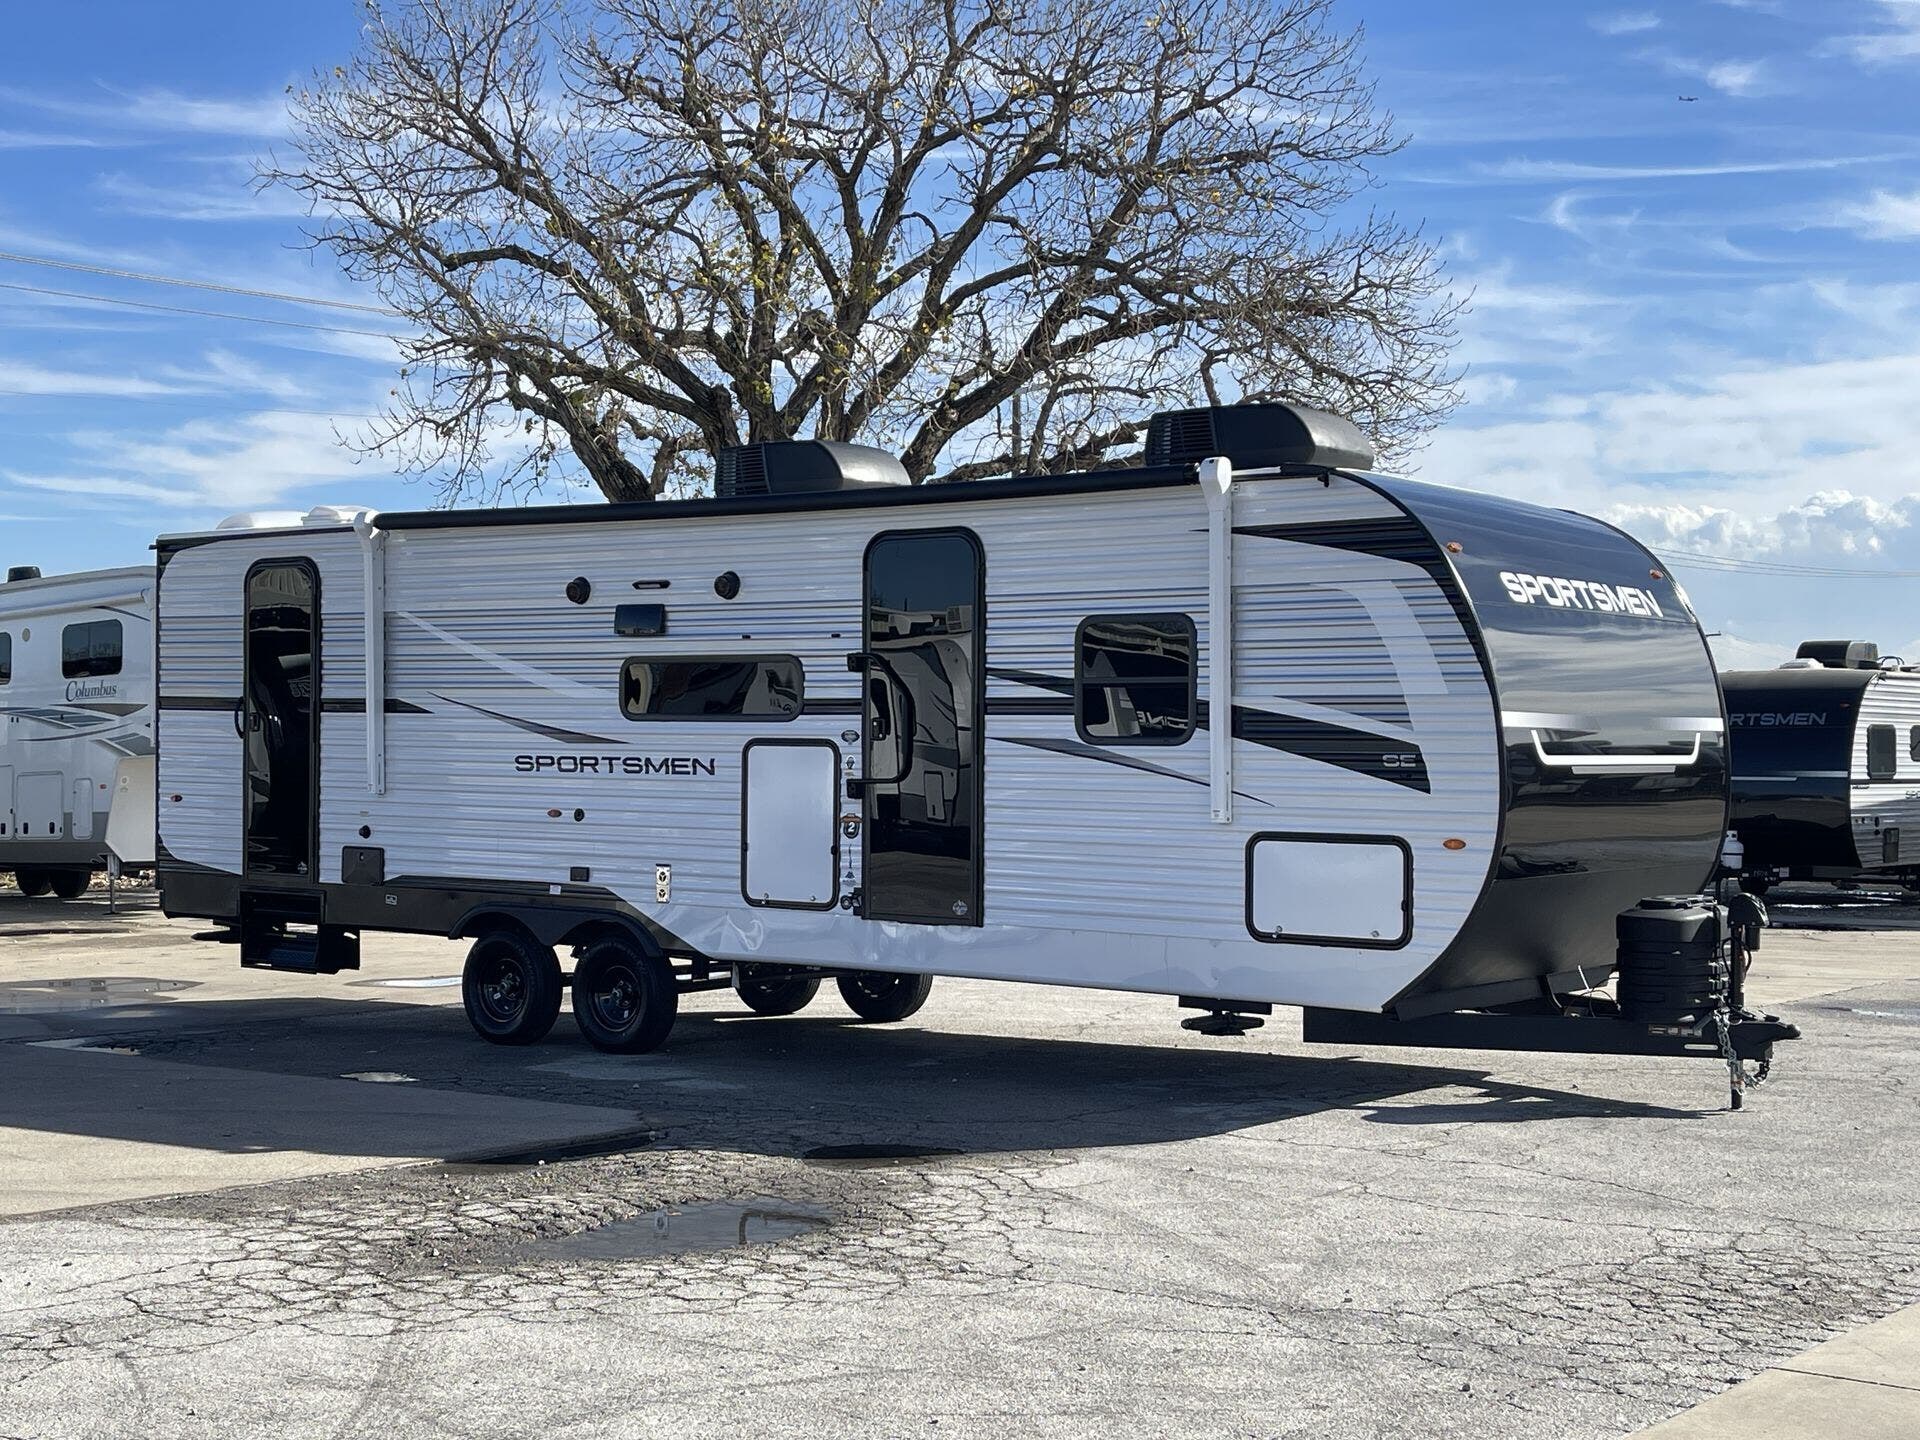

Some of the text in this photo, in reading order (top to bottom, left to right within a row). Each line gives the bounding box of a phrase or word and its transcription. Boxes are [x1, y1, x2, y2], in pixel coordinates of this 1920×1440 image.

[1500, 571, 1664, 618] SPORTSMEN
[65, 680, 117, 702] Columbus
[1728, 712, 1827, 726] RTSMEN
[514, 754, 716, 776] SPORTSMEN
[848, 821, 856, 832] 2
